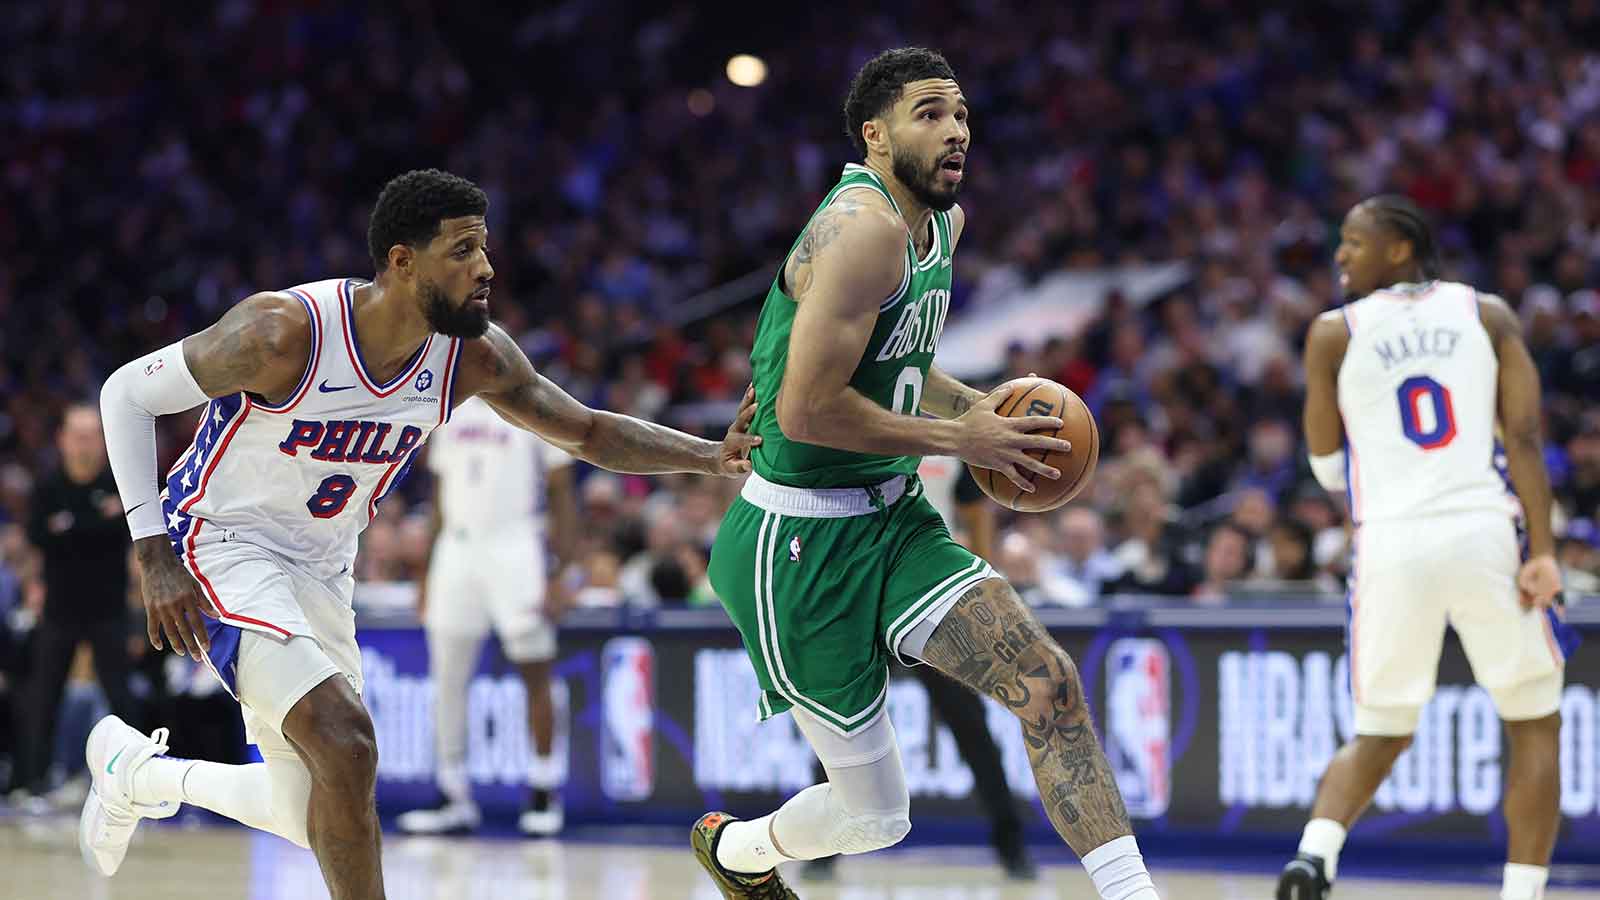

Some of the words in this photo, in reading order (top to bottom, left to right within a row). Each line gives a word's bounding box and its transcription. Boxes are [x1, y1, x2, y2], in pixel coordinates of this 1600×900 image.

[1374, 327, 1462, 371] MAXEY
[1396, 375, 1457, 450] 0
[306, 473, 357, 519] 8
